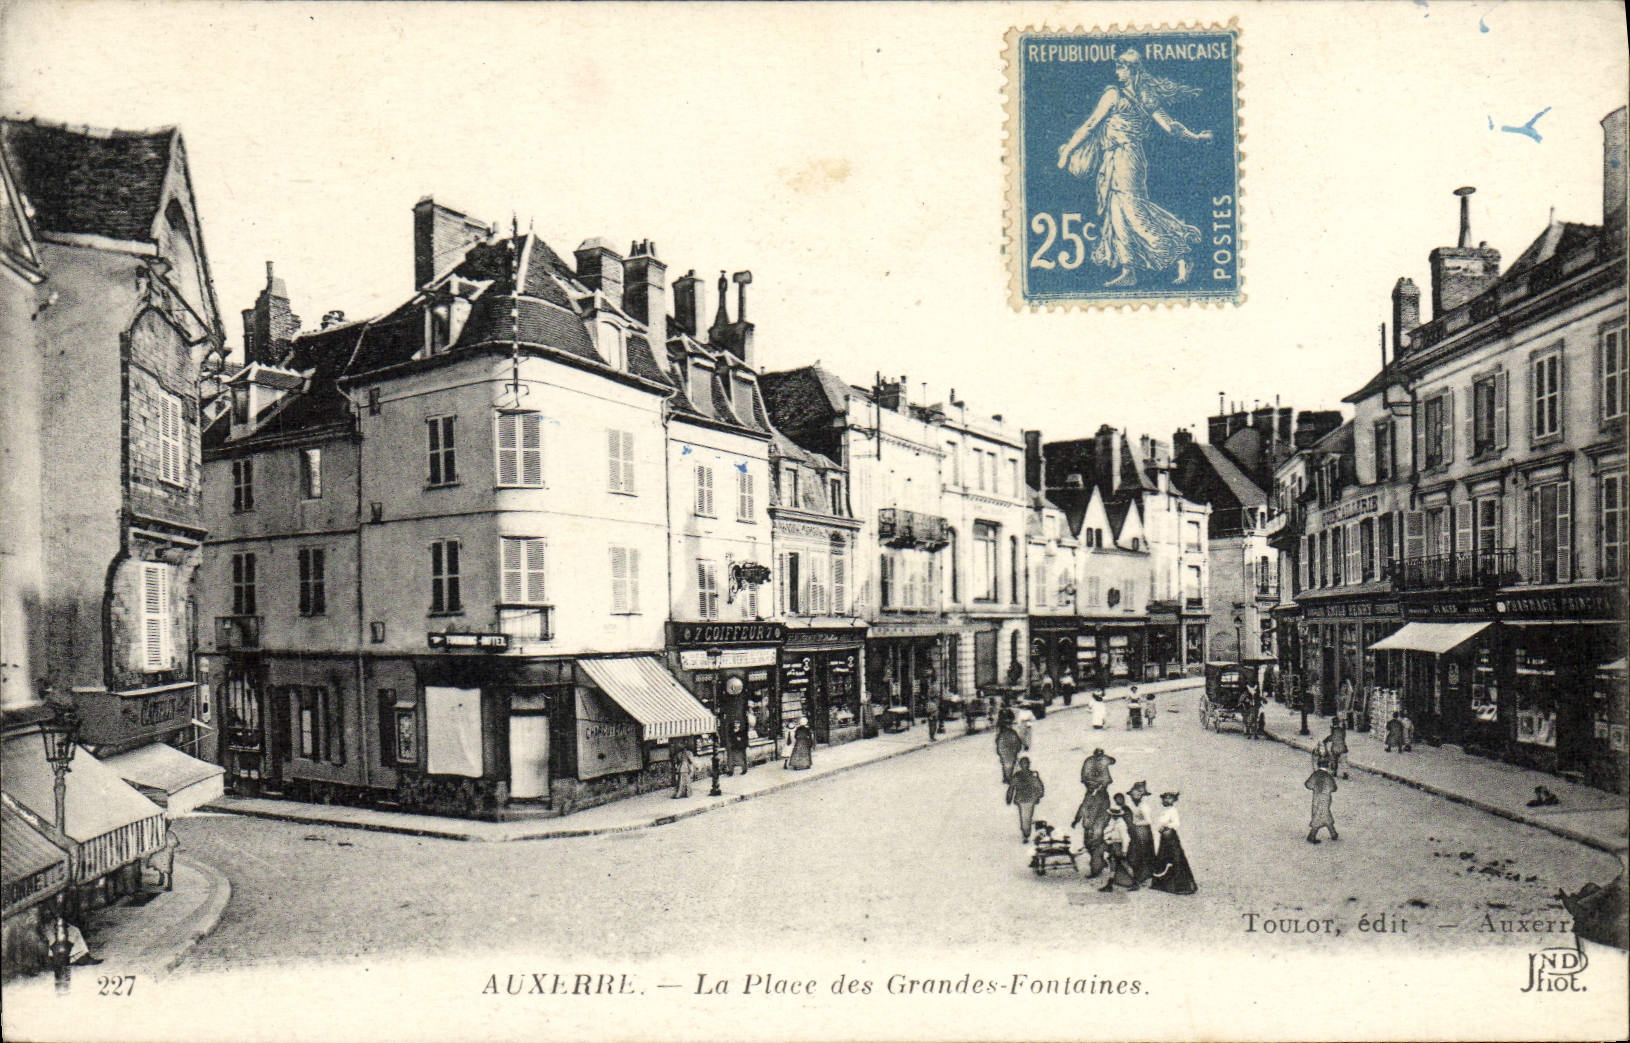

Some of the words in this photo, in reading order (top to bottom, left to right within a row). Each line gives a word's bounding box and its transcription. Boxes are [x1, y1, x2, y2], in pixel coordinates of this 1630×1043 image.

[1145, 42, 1229, 61] FRANÇAISE
[1212, 194, 1232, 281] POSTES
[705, 625, 764, 641] COIFFEUR
